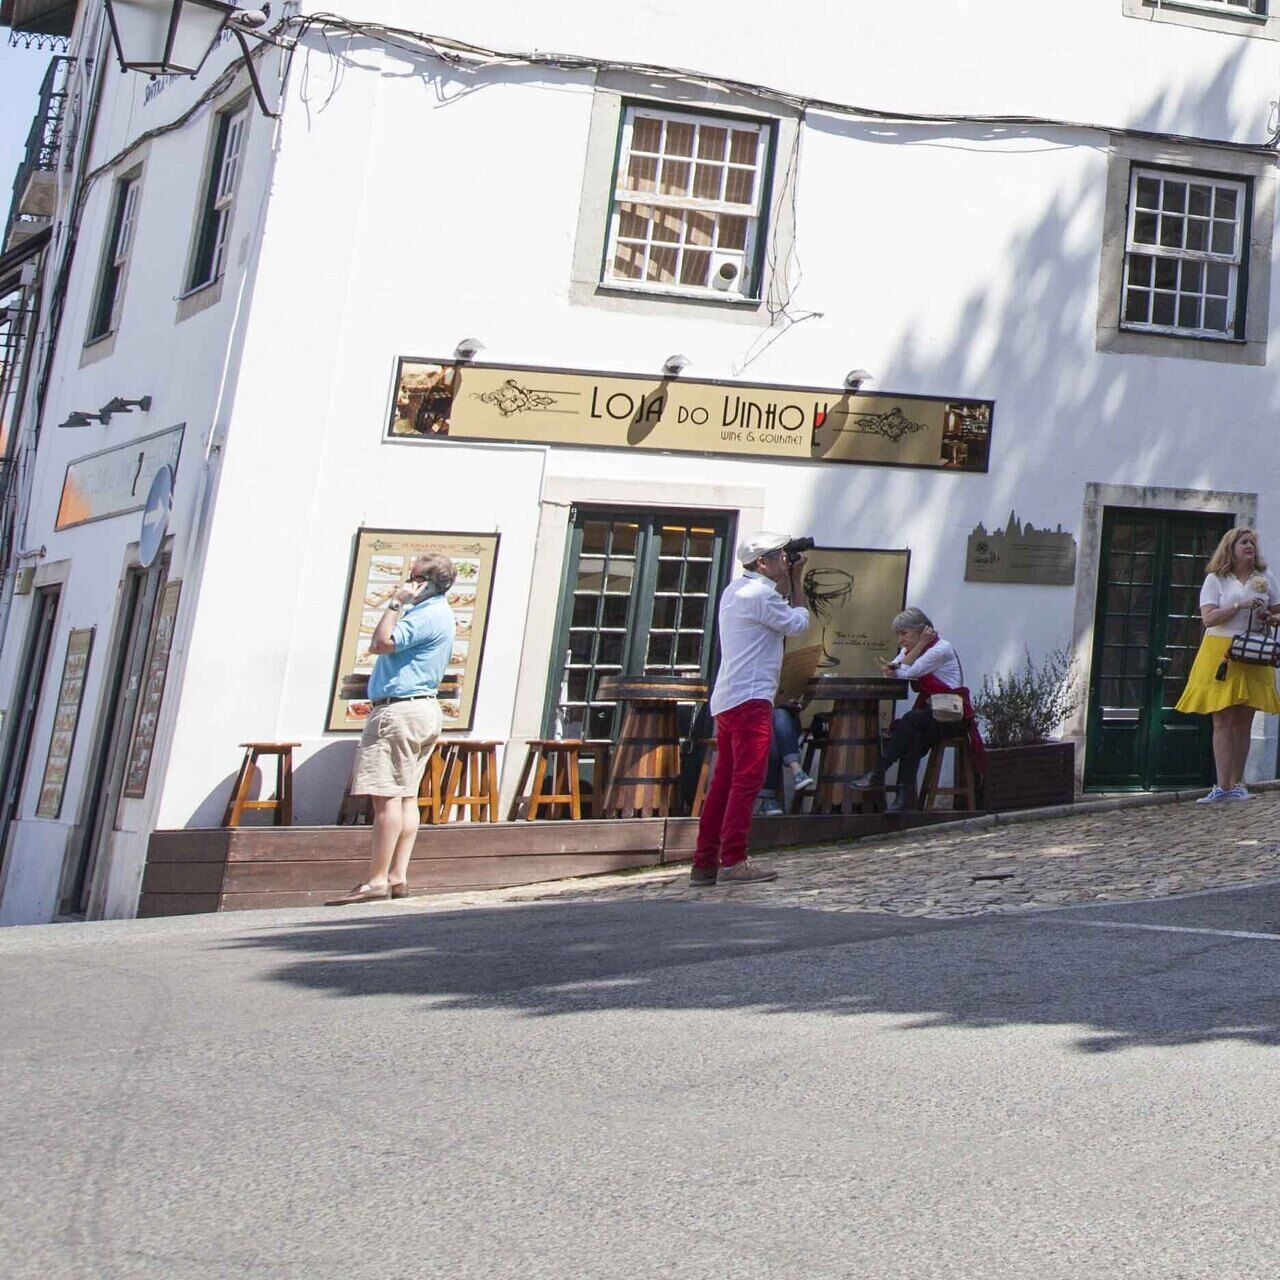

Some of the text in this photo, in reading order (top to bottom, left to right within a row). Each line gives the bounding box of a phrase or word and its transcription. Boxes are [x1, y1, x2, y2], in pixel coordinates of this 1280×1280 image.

[590, 386, 664, 423] LOJA
[720, 431, 804, 445] WINE & GOURMET
